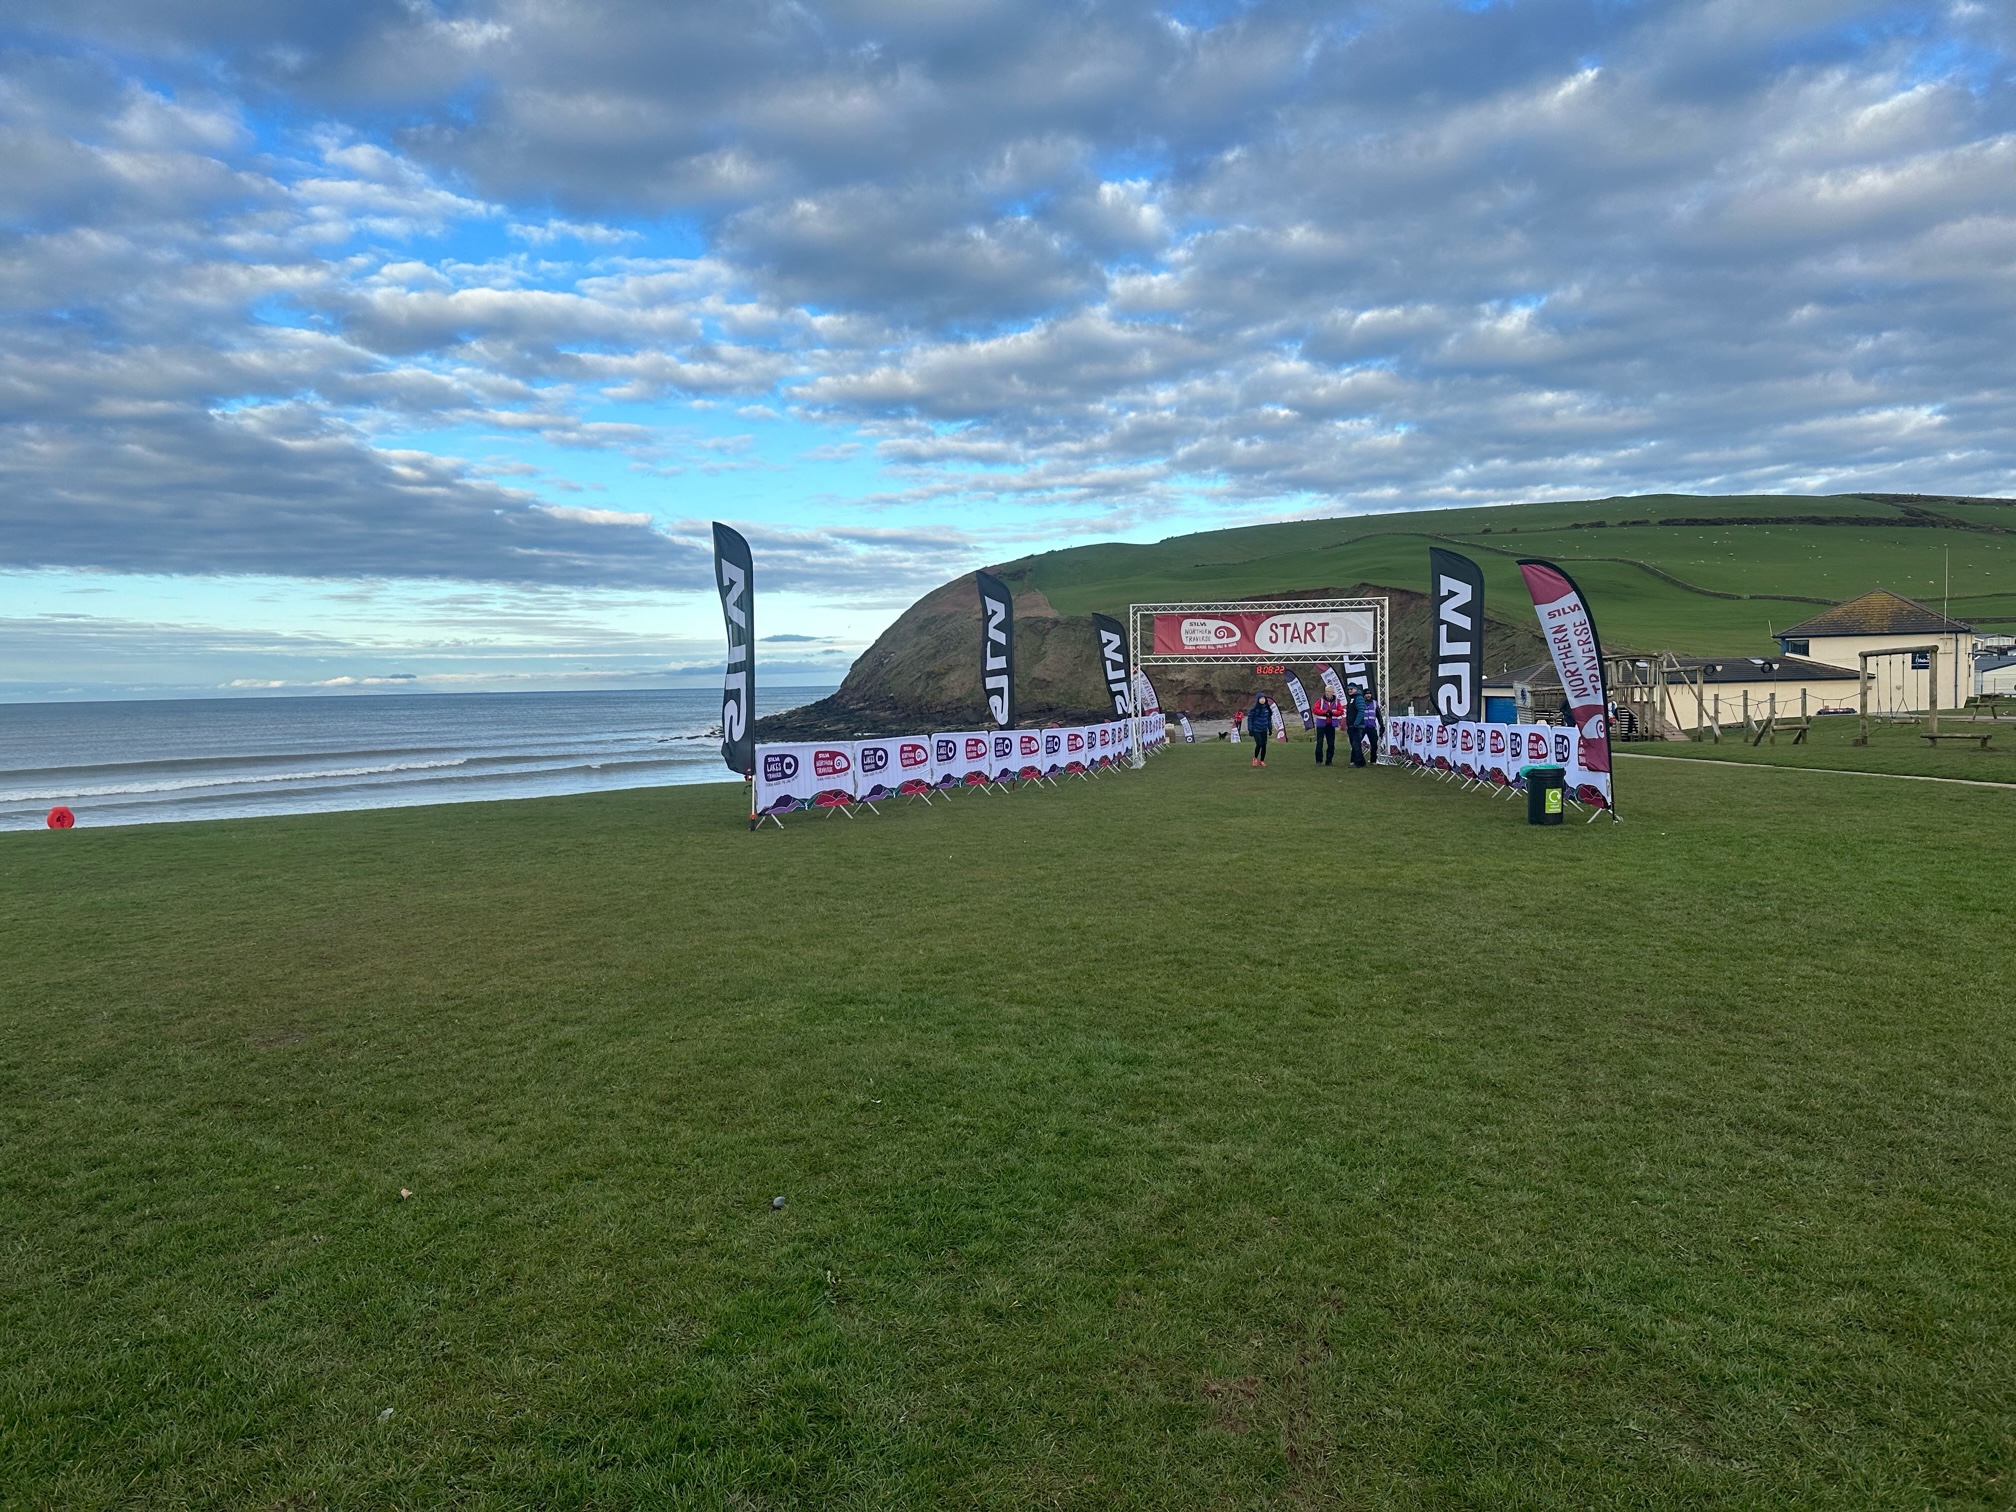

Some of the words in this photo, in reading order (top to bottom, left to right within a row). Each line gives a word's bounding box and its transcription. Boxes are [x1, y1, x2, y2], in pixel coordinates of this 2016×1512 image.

[1547, 603, 1582, 620] SILVA
[1185, 635, 1211, 643] TRAVERSE
[1268, 621, 1330, 645] START
[1549, 623, 1591, 699] NORTHERN
[1573, 618, 1601, 695] TRAVERSE
[766, 762, 782, 772] LAKES
